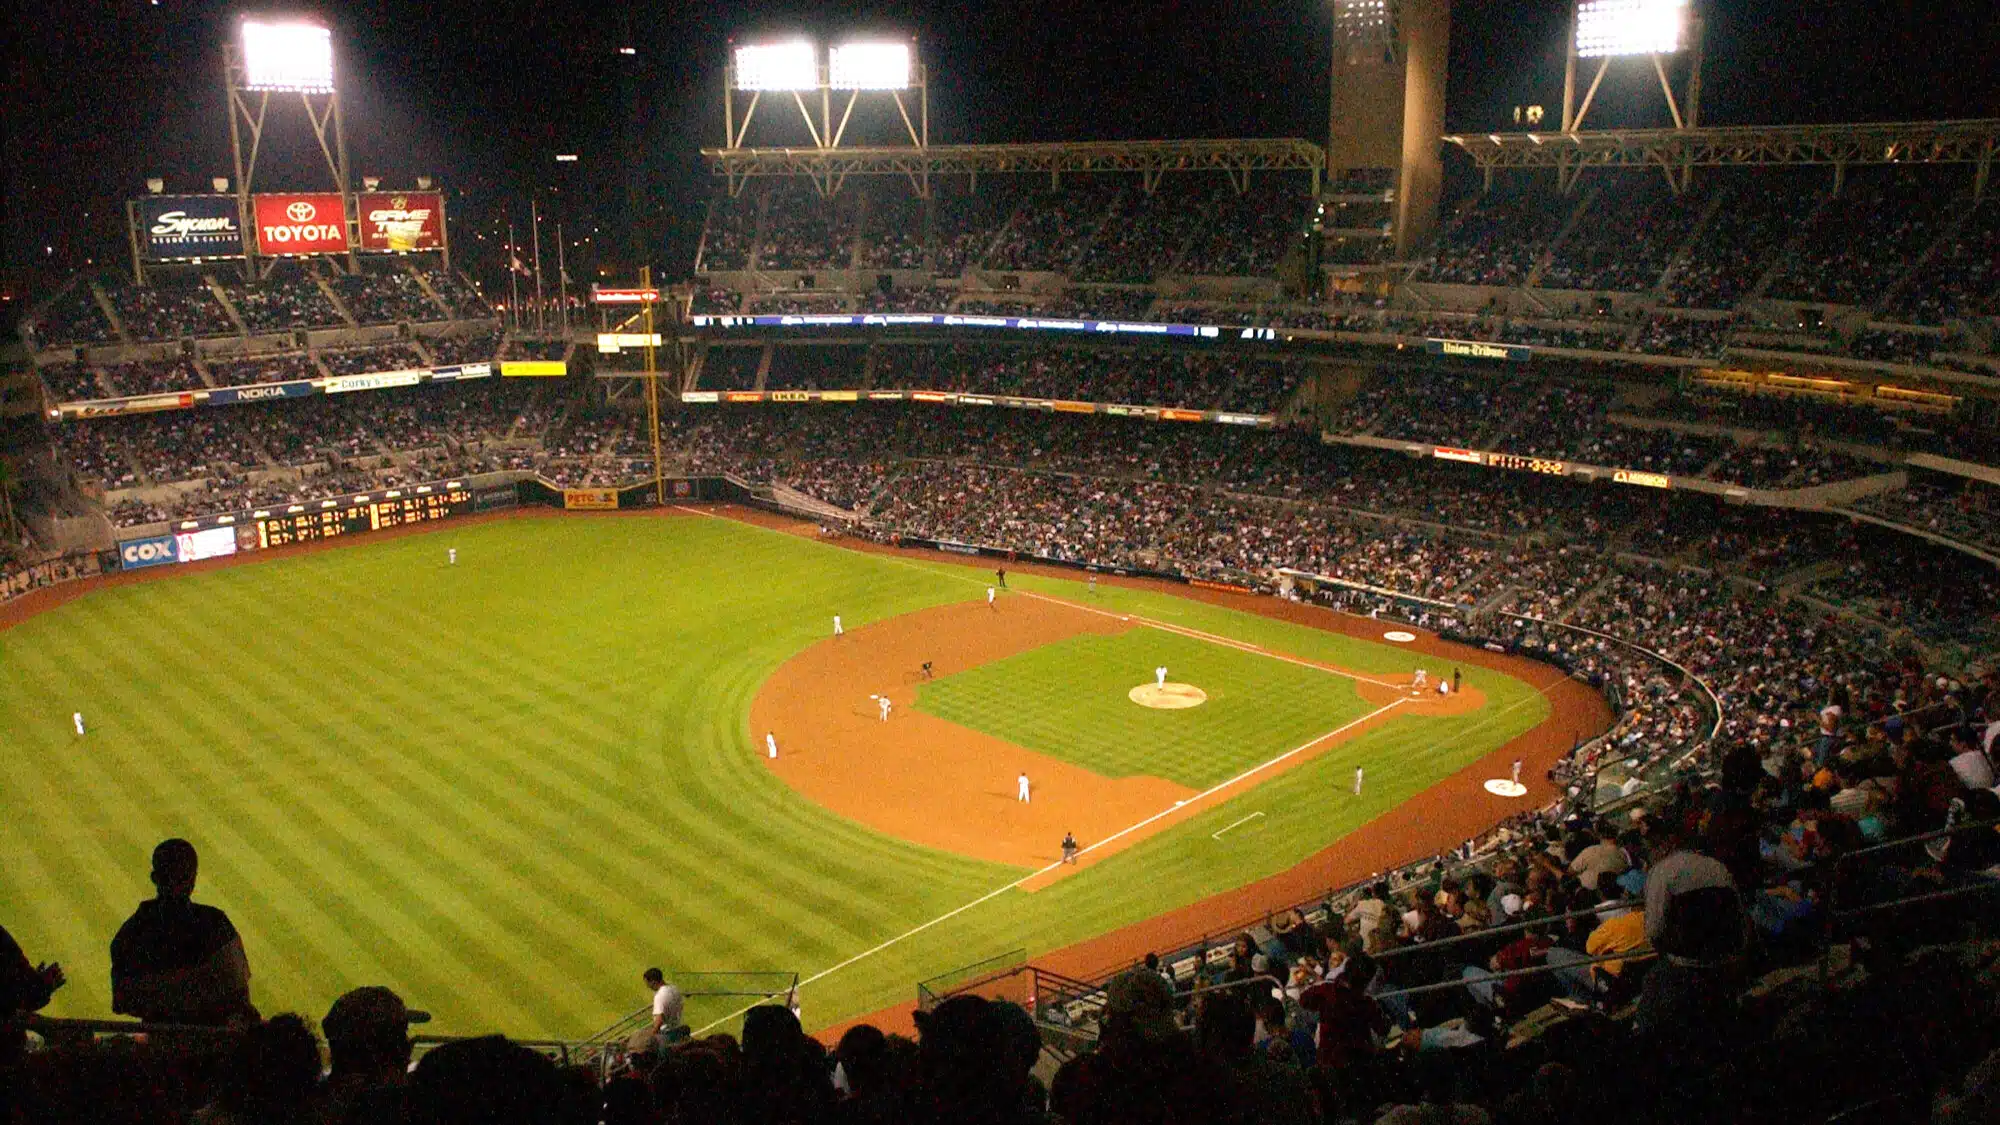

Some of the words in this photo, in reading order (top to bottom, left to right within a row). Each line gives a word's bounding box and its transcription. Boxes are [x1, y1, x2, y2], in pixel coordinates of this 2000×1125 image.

[369, 209, 431, 222] GAME
[151, 211, 237, 237] Sycuan
[264, 225, 341, 242] TOYOTA
[237, 386, 286, 400] NOKIA
[775, 391, 805, 400] IKEA
[124, 541, 172, 562] COX
